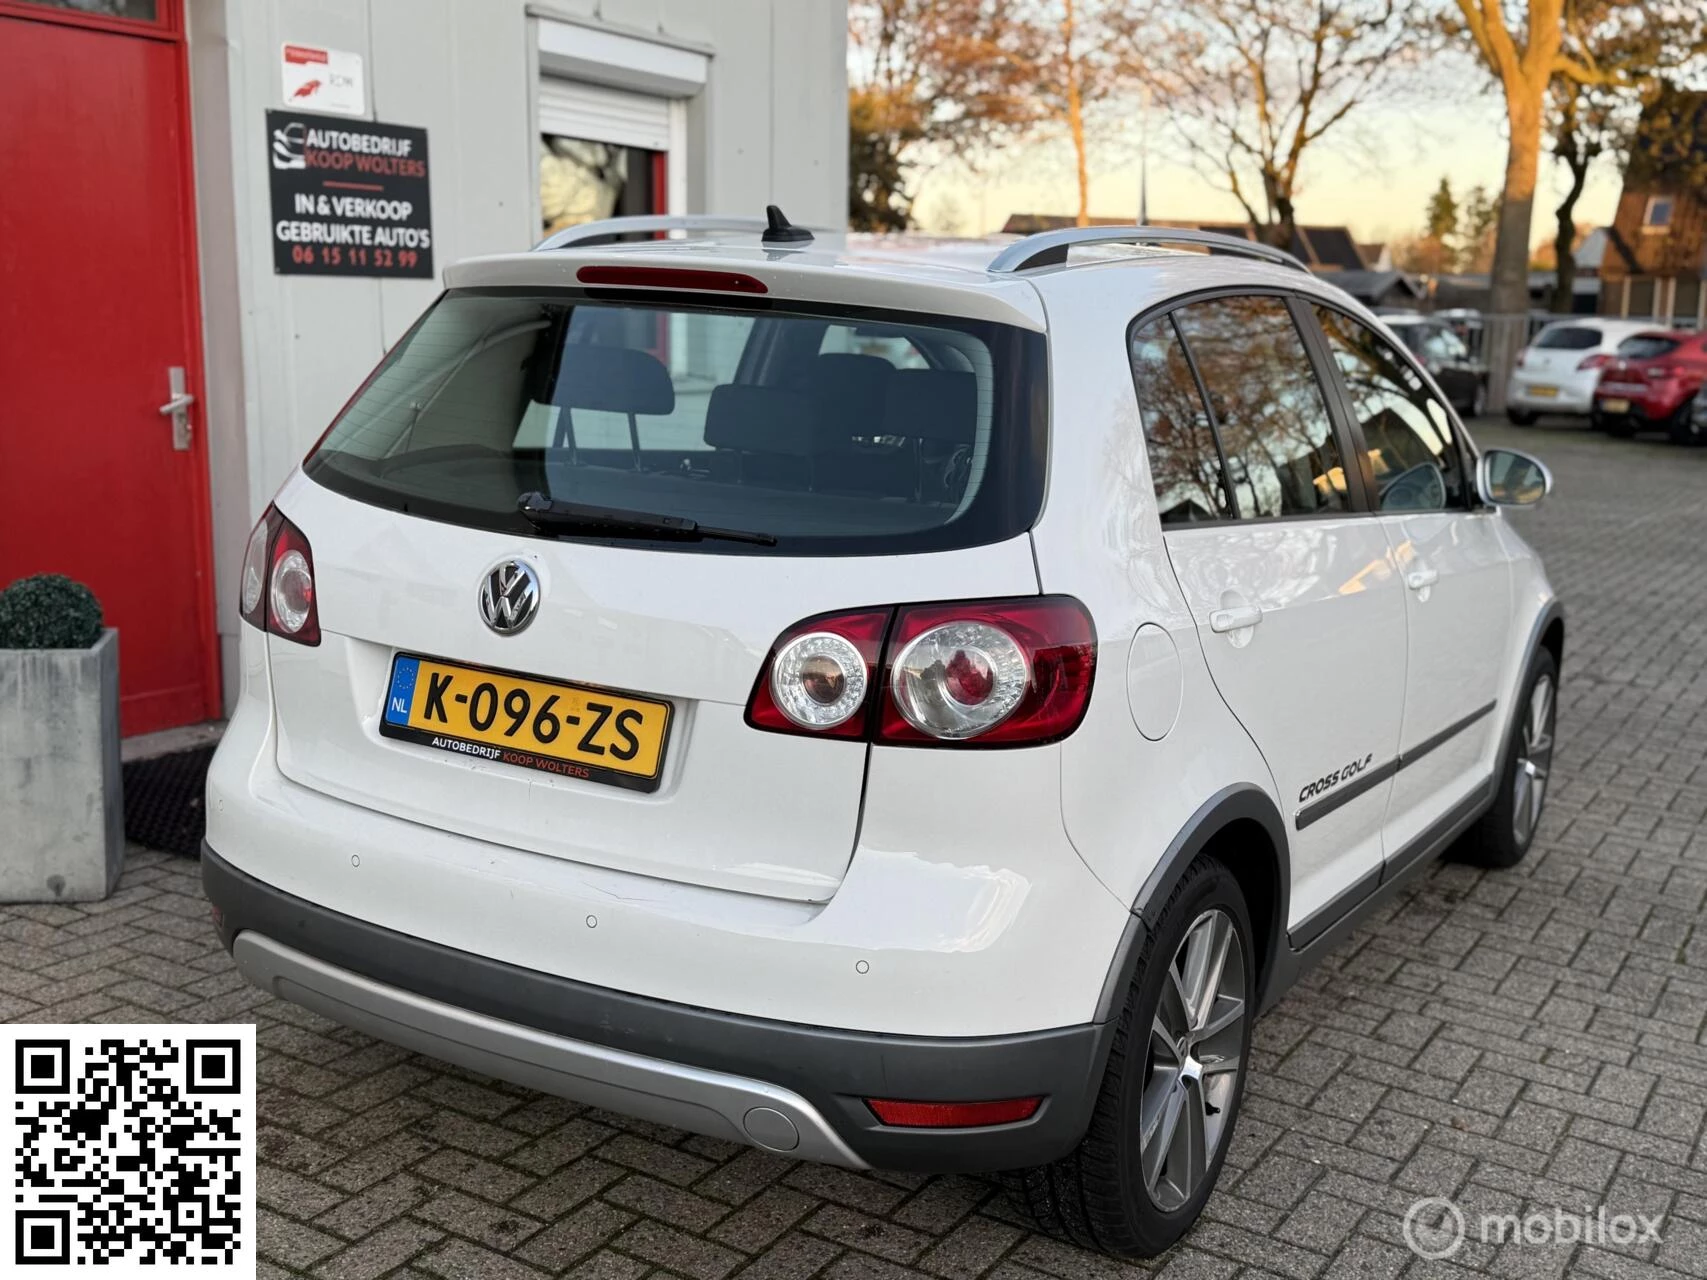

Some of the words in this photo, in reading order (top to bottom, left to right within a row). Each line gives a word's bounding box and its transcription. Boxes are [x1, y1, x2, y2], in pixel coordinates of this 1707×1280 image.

[306, 129, 412, 156] AUTOBEDRIJF
[305, 149, 353, 169] KOOP
[355, 155, 425, 176] WOLTERS
[294, 194, 315, 214] IN
[317, 195, 331, 215] &
[331, 196, 413, 221] VERKOOP
[276, 220, 373, 246] GEBRUIKTE
[374, 226, 430, 248] AUTO'S
[292, 245, 314, 264] 06
[322, 246, 341, 265] 15
[348, 248, 366, 266] 11
[374, 248, 393, 267] 52
[398, 250, 418, 268] 99
[391, 696, 407, 714] NL
[423, 672, 643, 761] K-096-ZS
[431, 736, 501, 760] AUTOBEDRIJF
[502, 750, 534, 767] KOOP
[535, 757, 590, 779] WOLTERS
[1299, 769, 1341, 802] CROSS
[1341, 753, 1373, 781] GOLF
